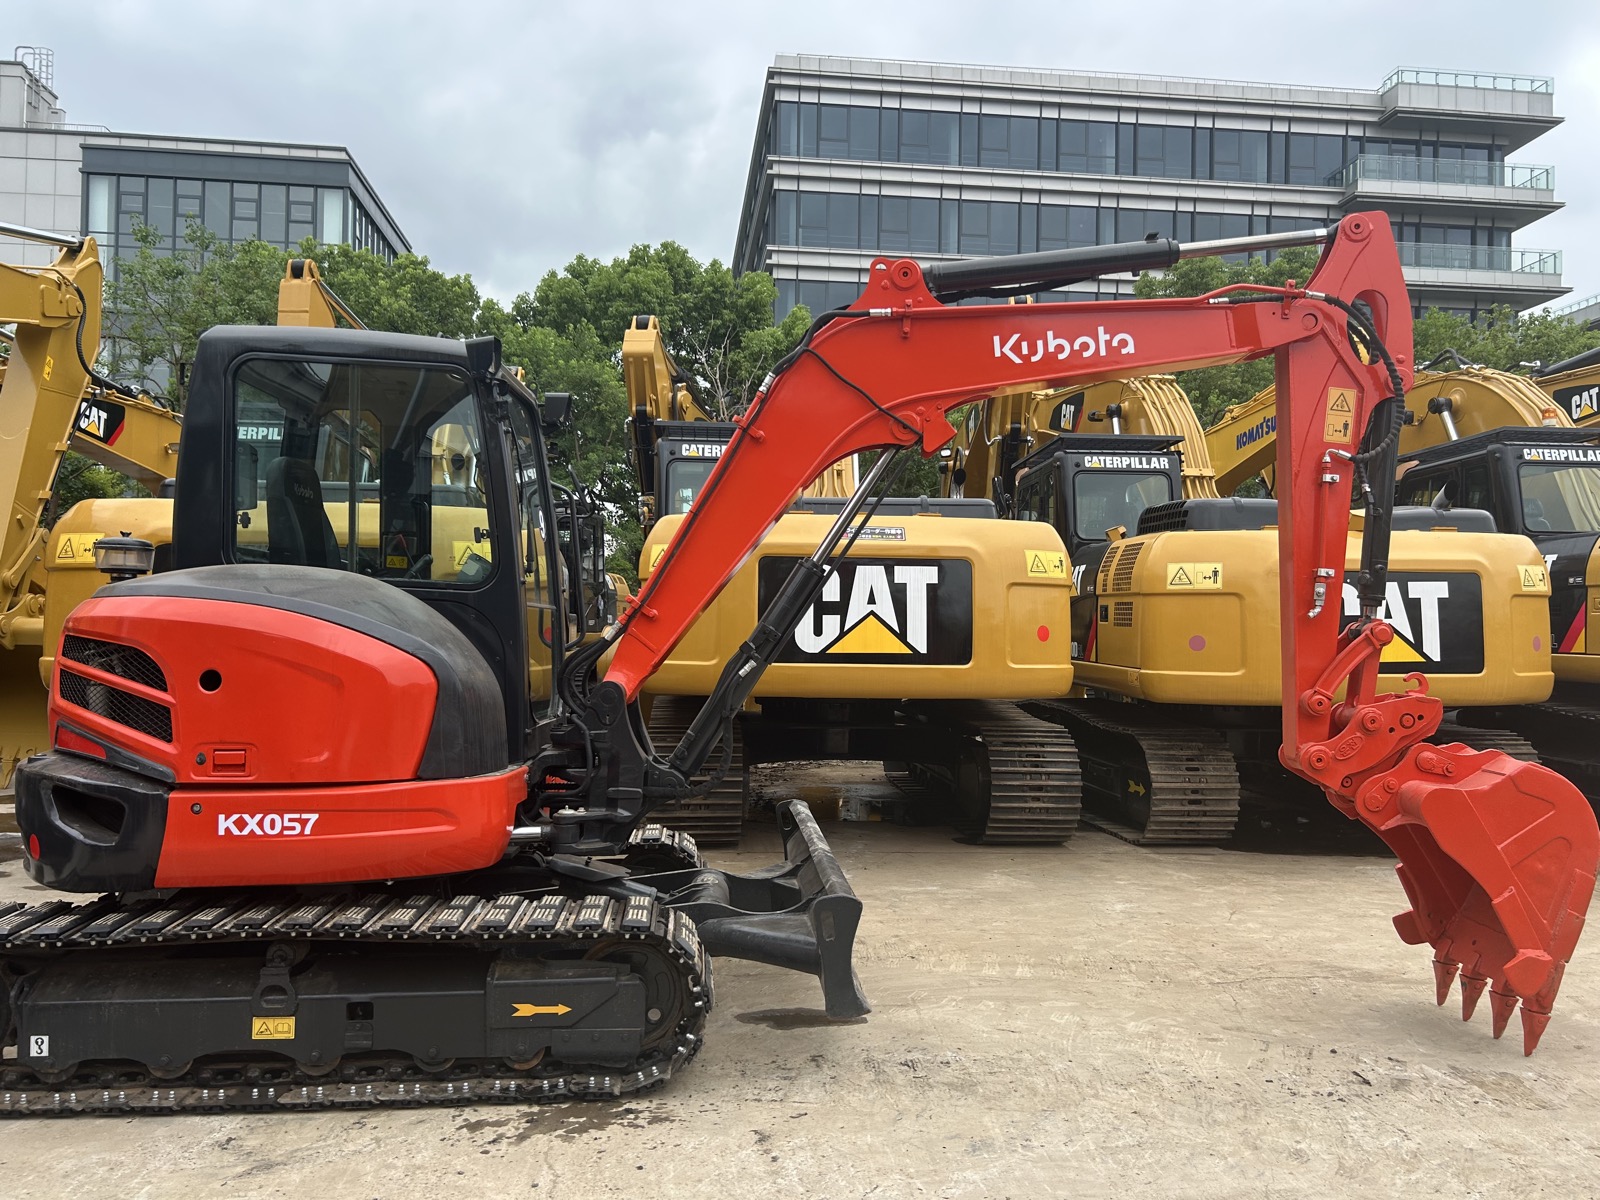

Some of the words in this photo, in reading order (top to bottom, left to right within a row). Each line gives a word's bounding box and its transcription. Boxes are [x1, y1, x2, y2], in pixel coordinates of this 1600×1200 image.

[993, 326, 1135, 364] Kubota
[1061, 404, 1075, 430] CAT
[1571, 387, 1599, 420] CAT
[80, 402, 107, 438] CAT
[237, 426, 284, 440] ERPIL
[1236, 416, 1276, 450] KOMATSU
[1084, 456, 1169, 469] CATERPILLAR
[1071, 564, 1087, 595] AT
[794, 564, 939, 654] CAT
[218, 813, 319, 836] KX057
